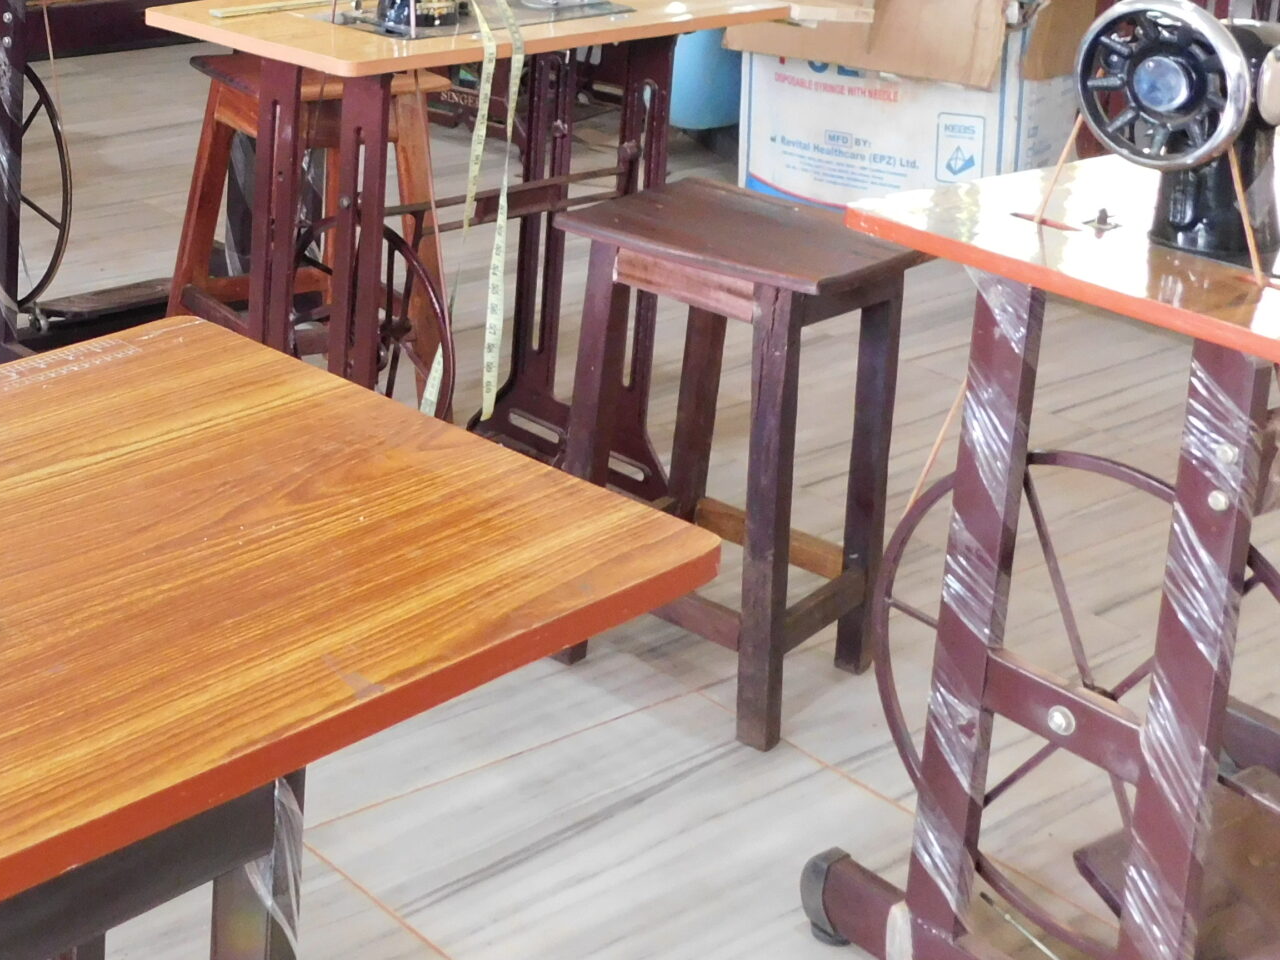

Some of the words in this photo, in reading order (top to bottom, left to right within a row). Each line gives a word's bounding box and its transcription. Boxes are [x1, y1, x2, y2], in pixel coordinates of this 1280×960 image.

[847, 86, 867, 98] WITH
[854, 138, 871, 147] BY:
[781, 136, 810, 151] Revital
[813, 144, 866, 162] Healthcare
[869, 153, 896, 168] (EPZ)
[900, 158, 920, 169] Ltd.
